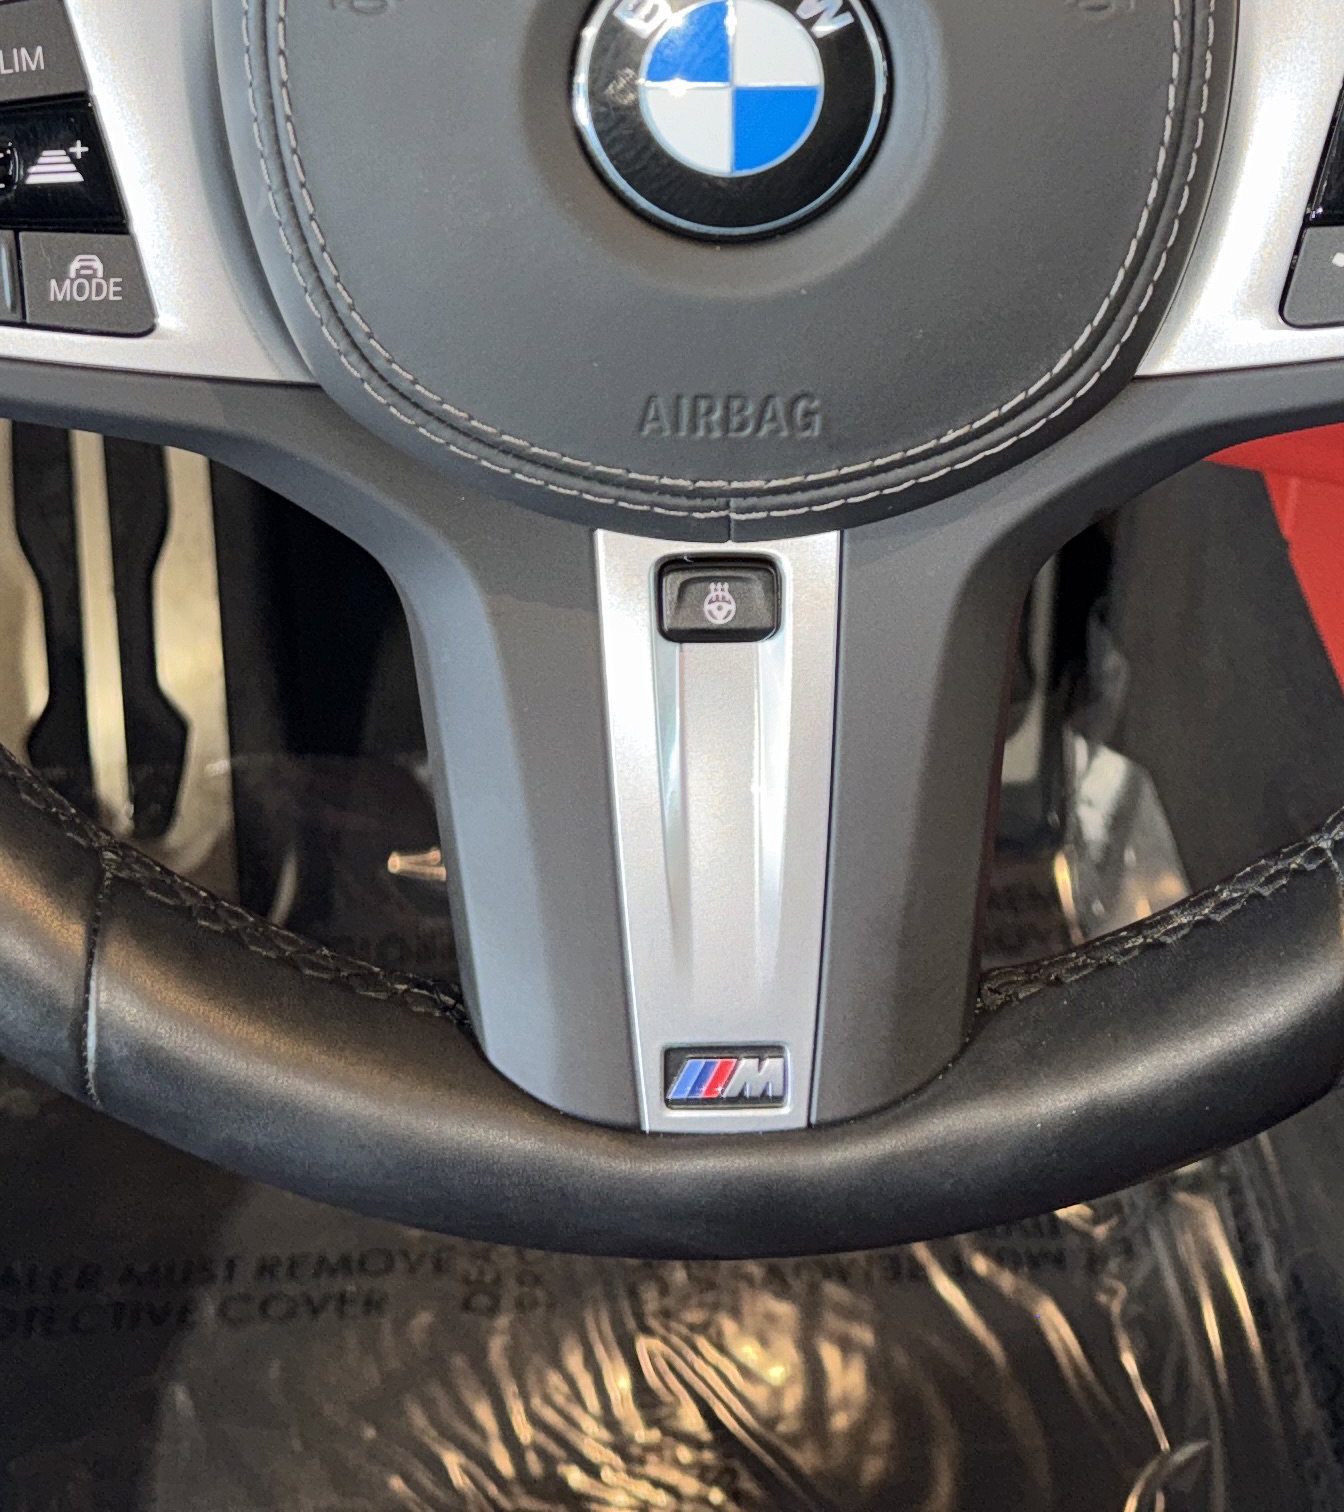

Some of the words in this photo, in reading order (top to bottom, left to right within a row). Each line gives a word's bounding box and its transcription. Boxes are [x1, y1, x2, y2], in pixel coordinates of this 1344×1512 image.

[50, 278, 123, 302] MODE
[637, 394, 823, 441] AIRBAG
[255, 1244, 458, 1284] REMOVE
[216, 1289, 391, 1328] COVER
